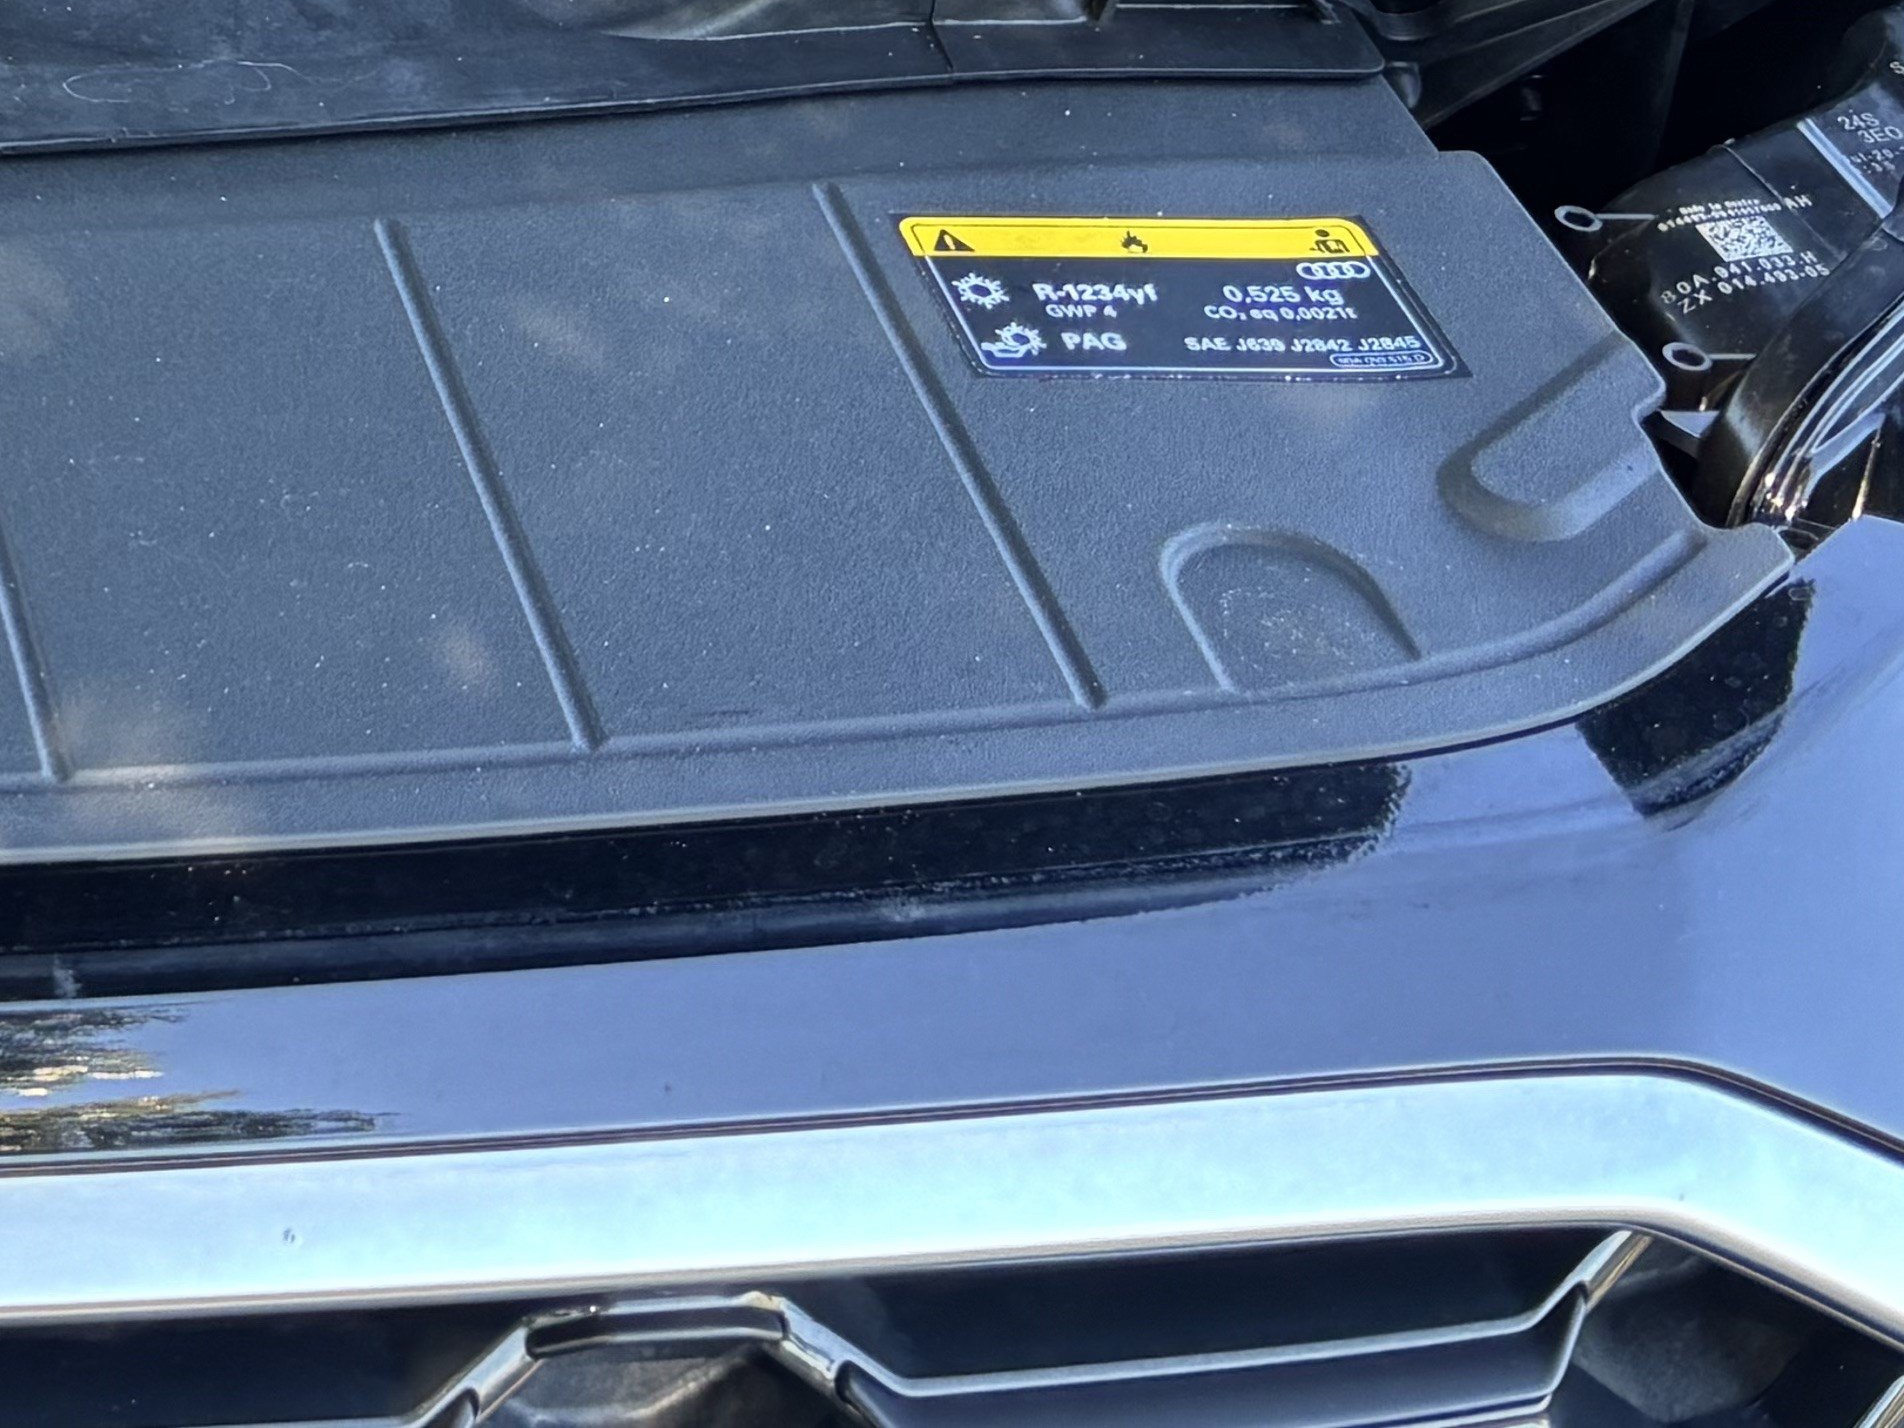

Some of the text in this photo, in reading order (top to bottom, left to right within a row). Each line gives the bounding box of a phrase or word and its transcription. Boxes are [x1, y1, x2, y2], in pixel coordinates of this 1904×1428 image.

[1033, 282, 1158, 304] R-1234yf
[1301, 285, 1345, 306] kg
[1678, 289, 1713, 314] ZX
[1061, 332, 1128, 352] PAG
[1184, 336, 1231, 352] SAE
